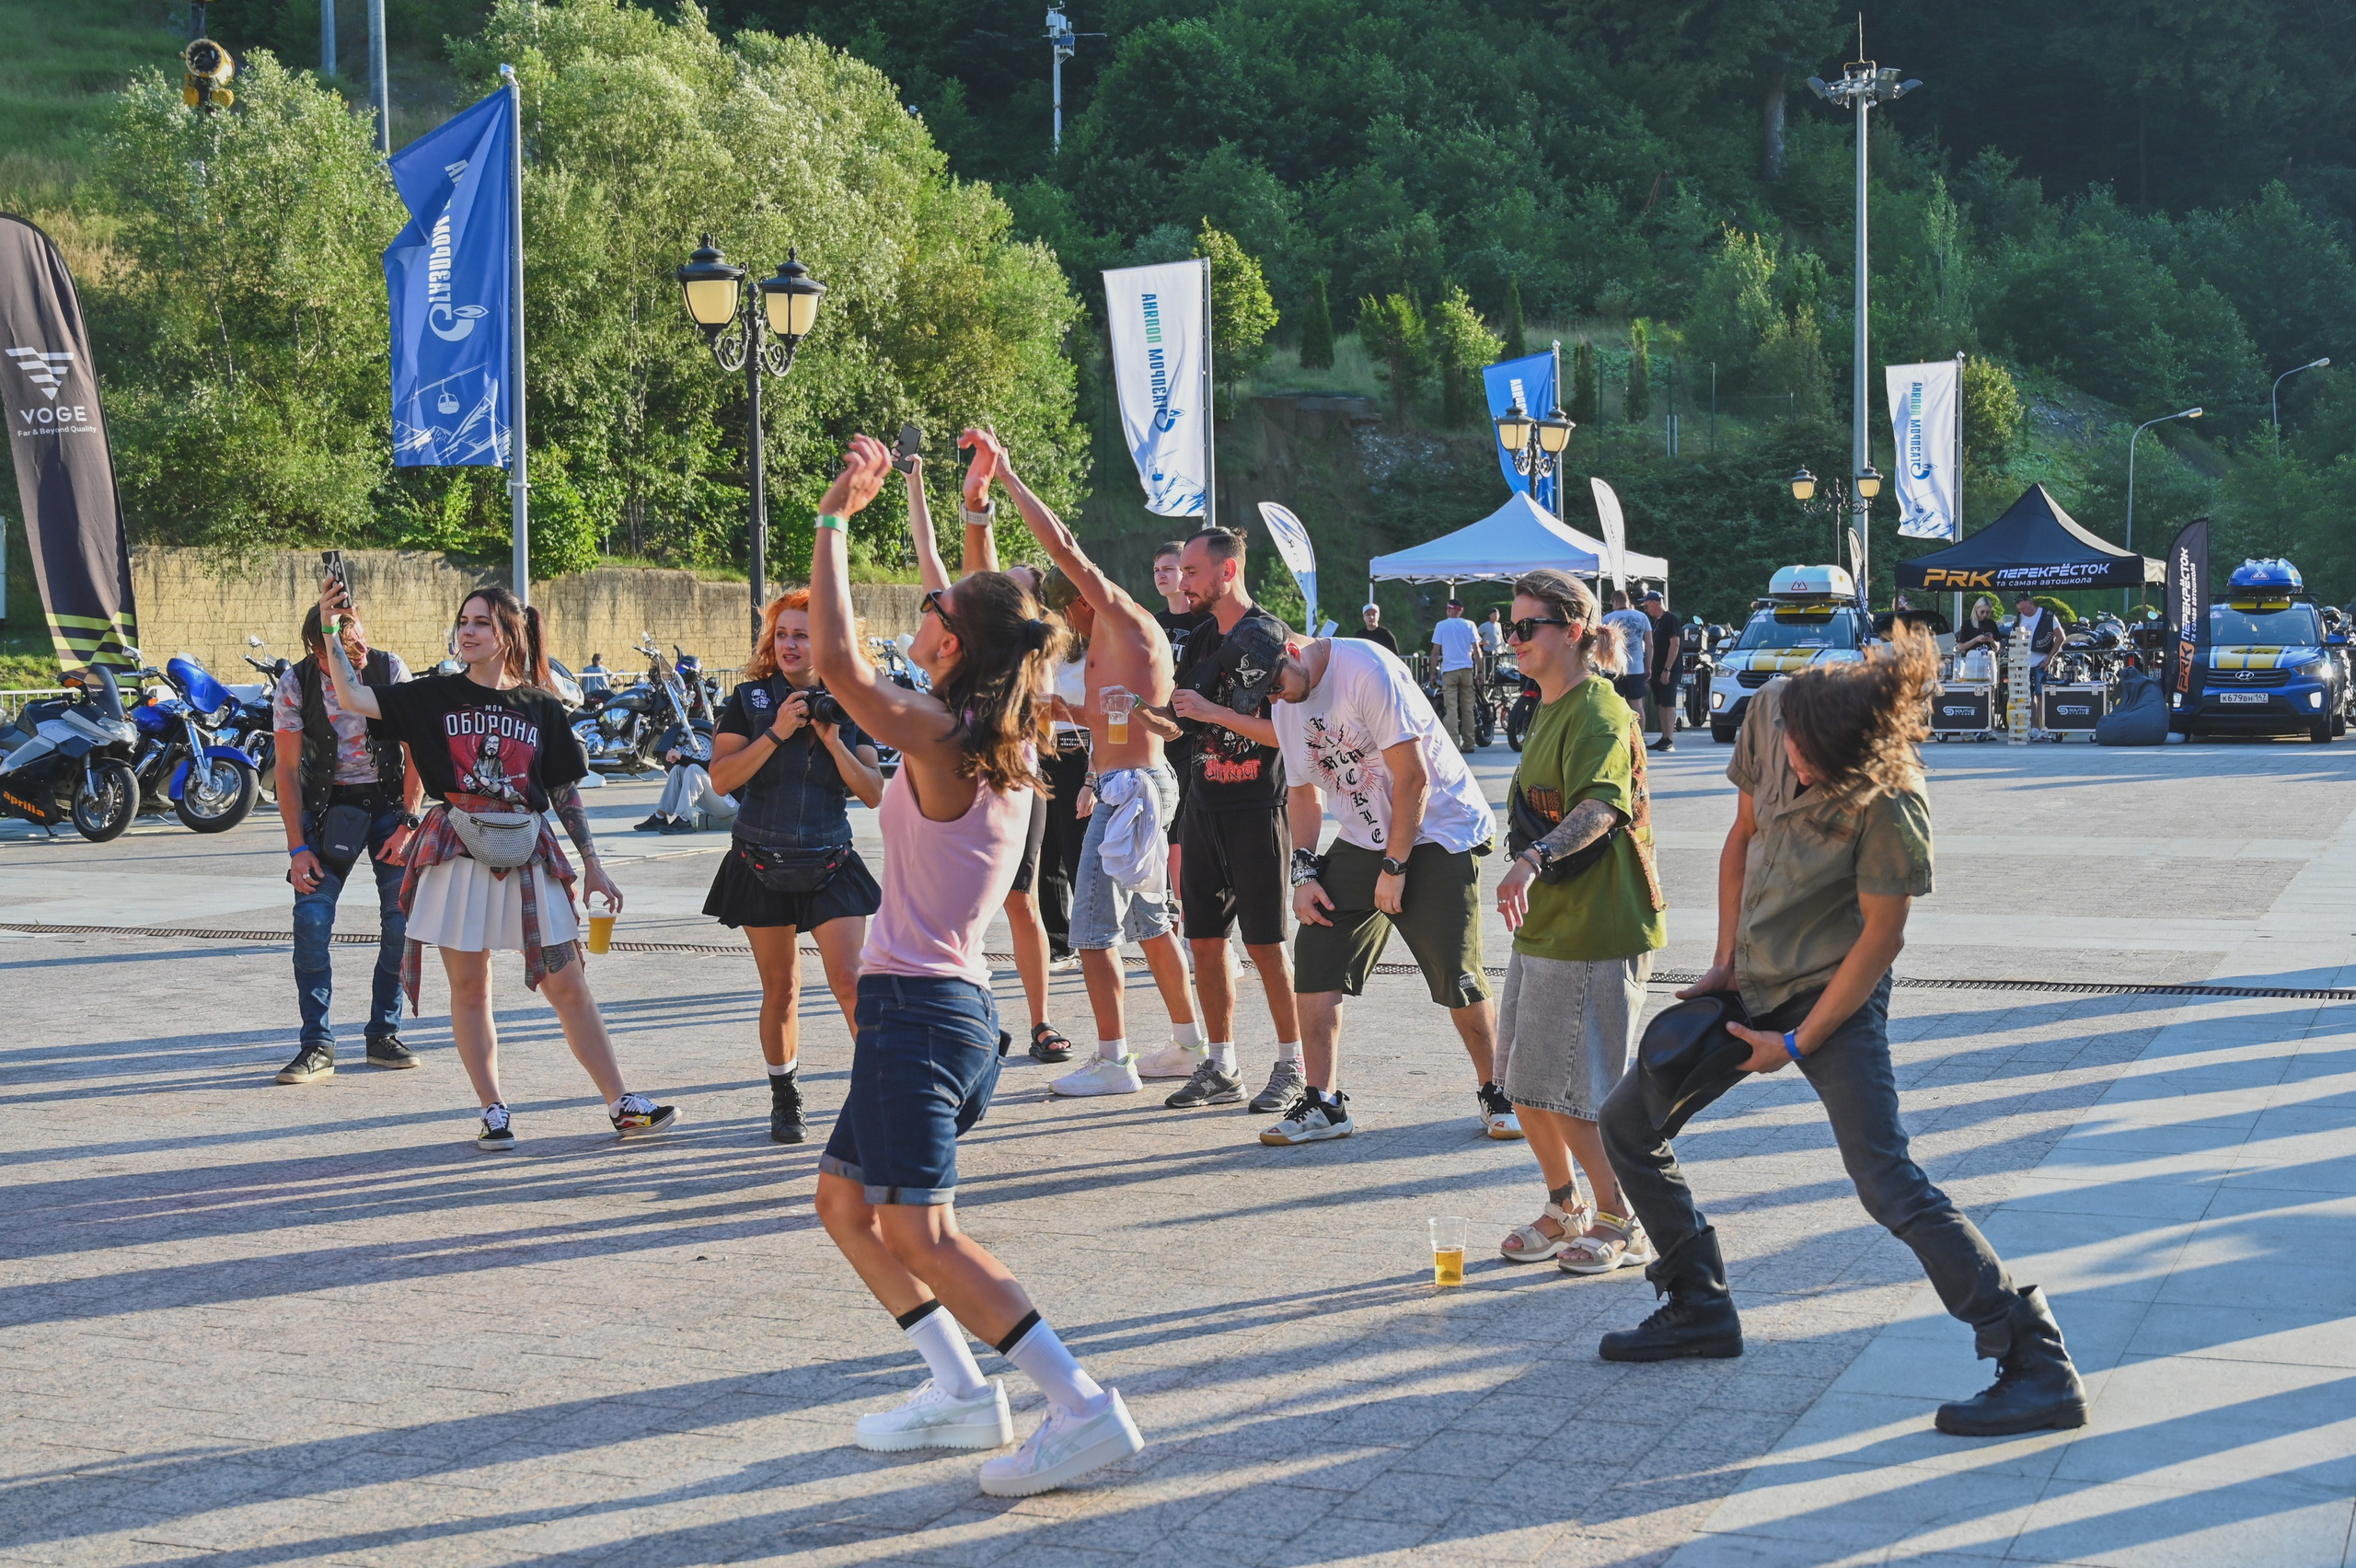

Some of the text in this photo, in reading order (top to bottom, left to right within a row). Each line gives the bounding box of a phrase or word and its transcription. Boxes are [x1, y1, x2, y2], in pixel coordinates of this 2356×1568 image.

[20, 406, 87, 424] VOGE
[40, 426, 70, 435] Beyond
[70, 425, 97, 433] Quality
[1923, 568, 1996, 587] PRK
[1997, 562, 2111, 579] ПЕРЕКРЁСТОК
[2039, 576, 2093, 586] автошкола
[2179, 547, 2191, 641] ПЕРЕКРЁСТОК
[2178, 647, 2194, 690] PRK
[485, 704, 502, 712] МОЯ
[445, 711, 538, 748] ОБОРОНА
[3, 791, 45, 817] aprilia
